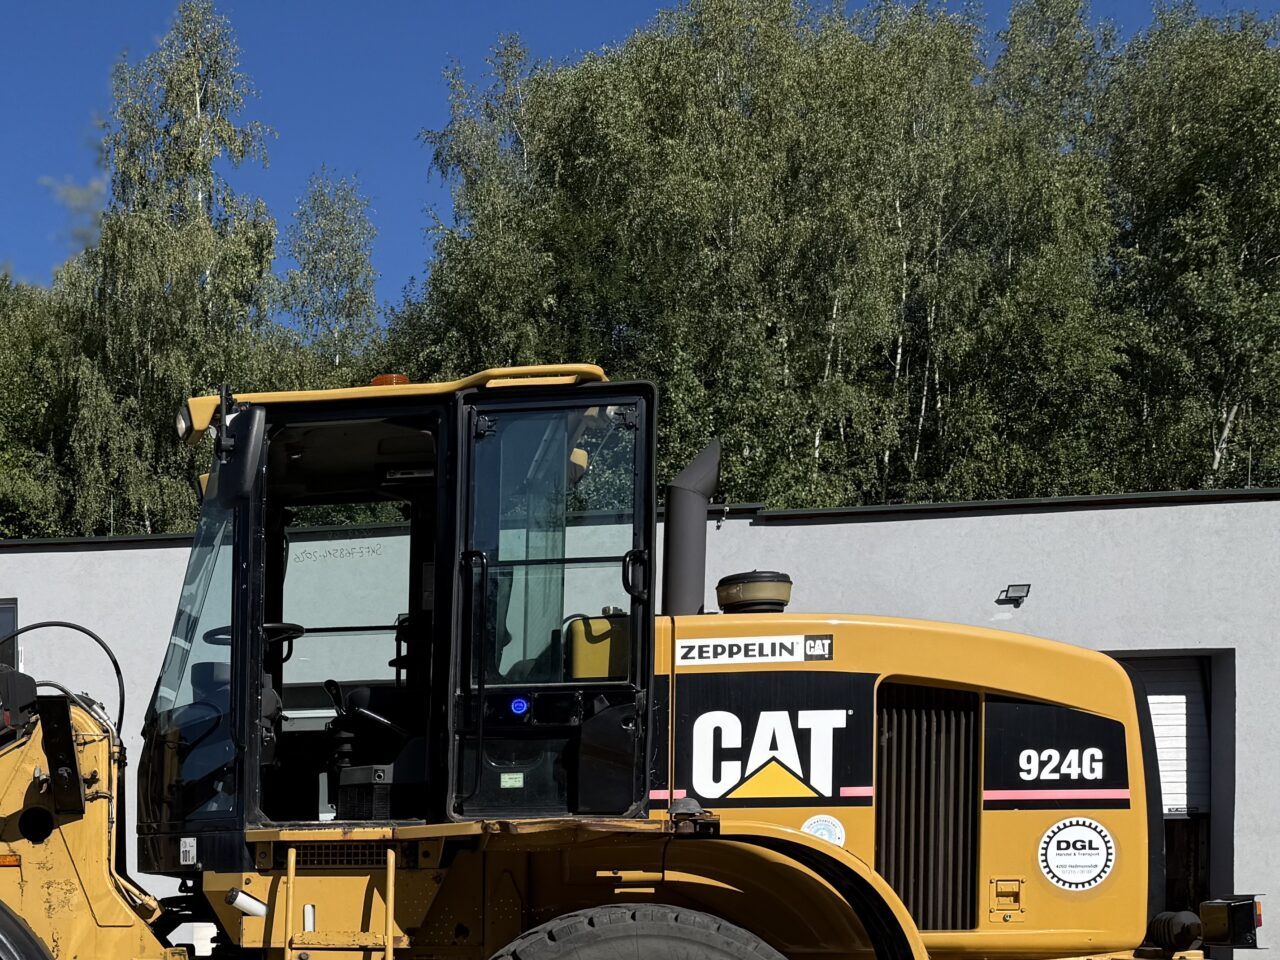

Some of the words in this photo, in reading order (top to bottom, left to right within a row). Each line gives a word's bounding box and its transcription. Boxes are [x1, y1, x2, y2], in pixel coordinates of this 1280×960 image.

[680, 641, 795, 660] ZEPPELIN
[805, 639, 831, 656] CAT
[692, 709, 847, 799] CAT
[1018, 747, 1104, 781] 924G
[1056, 839, 1100, 851] DGL
